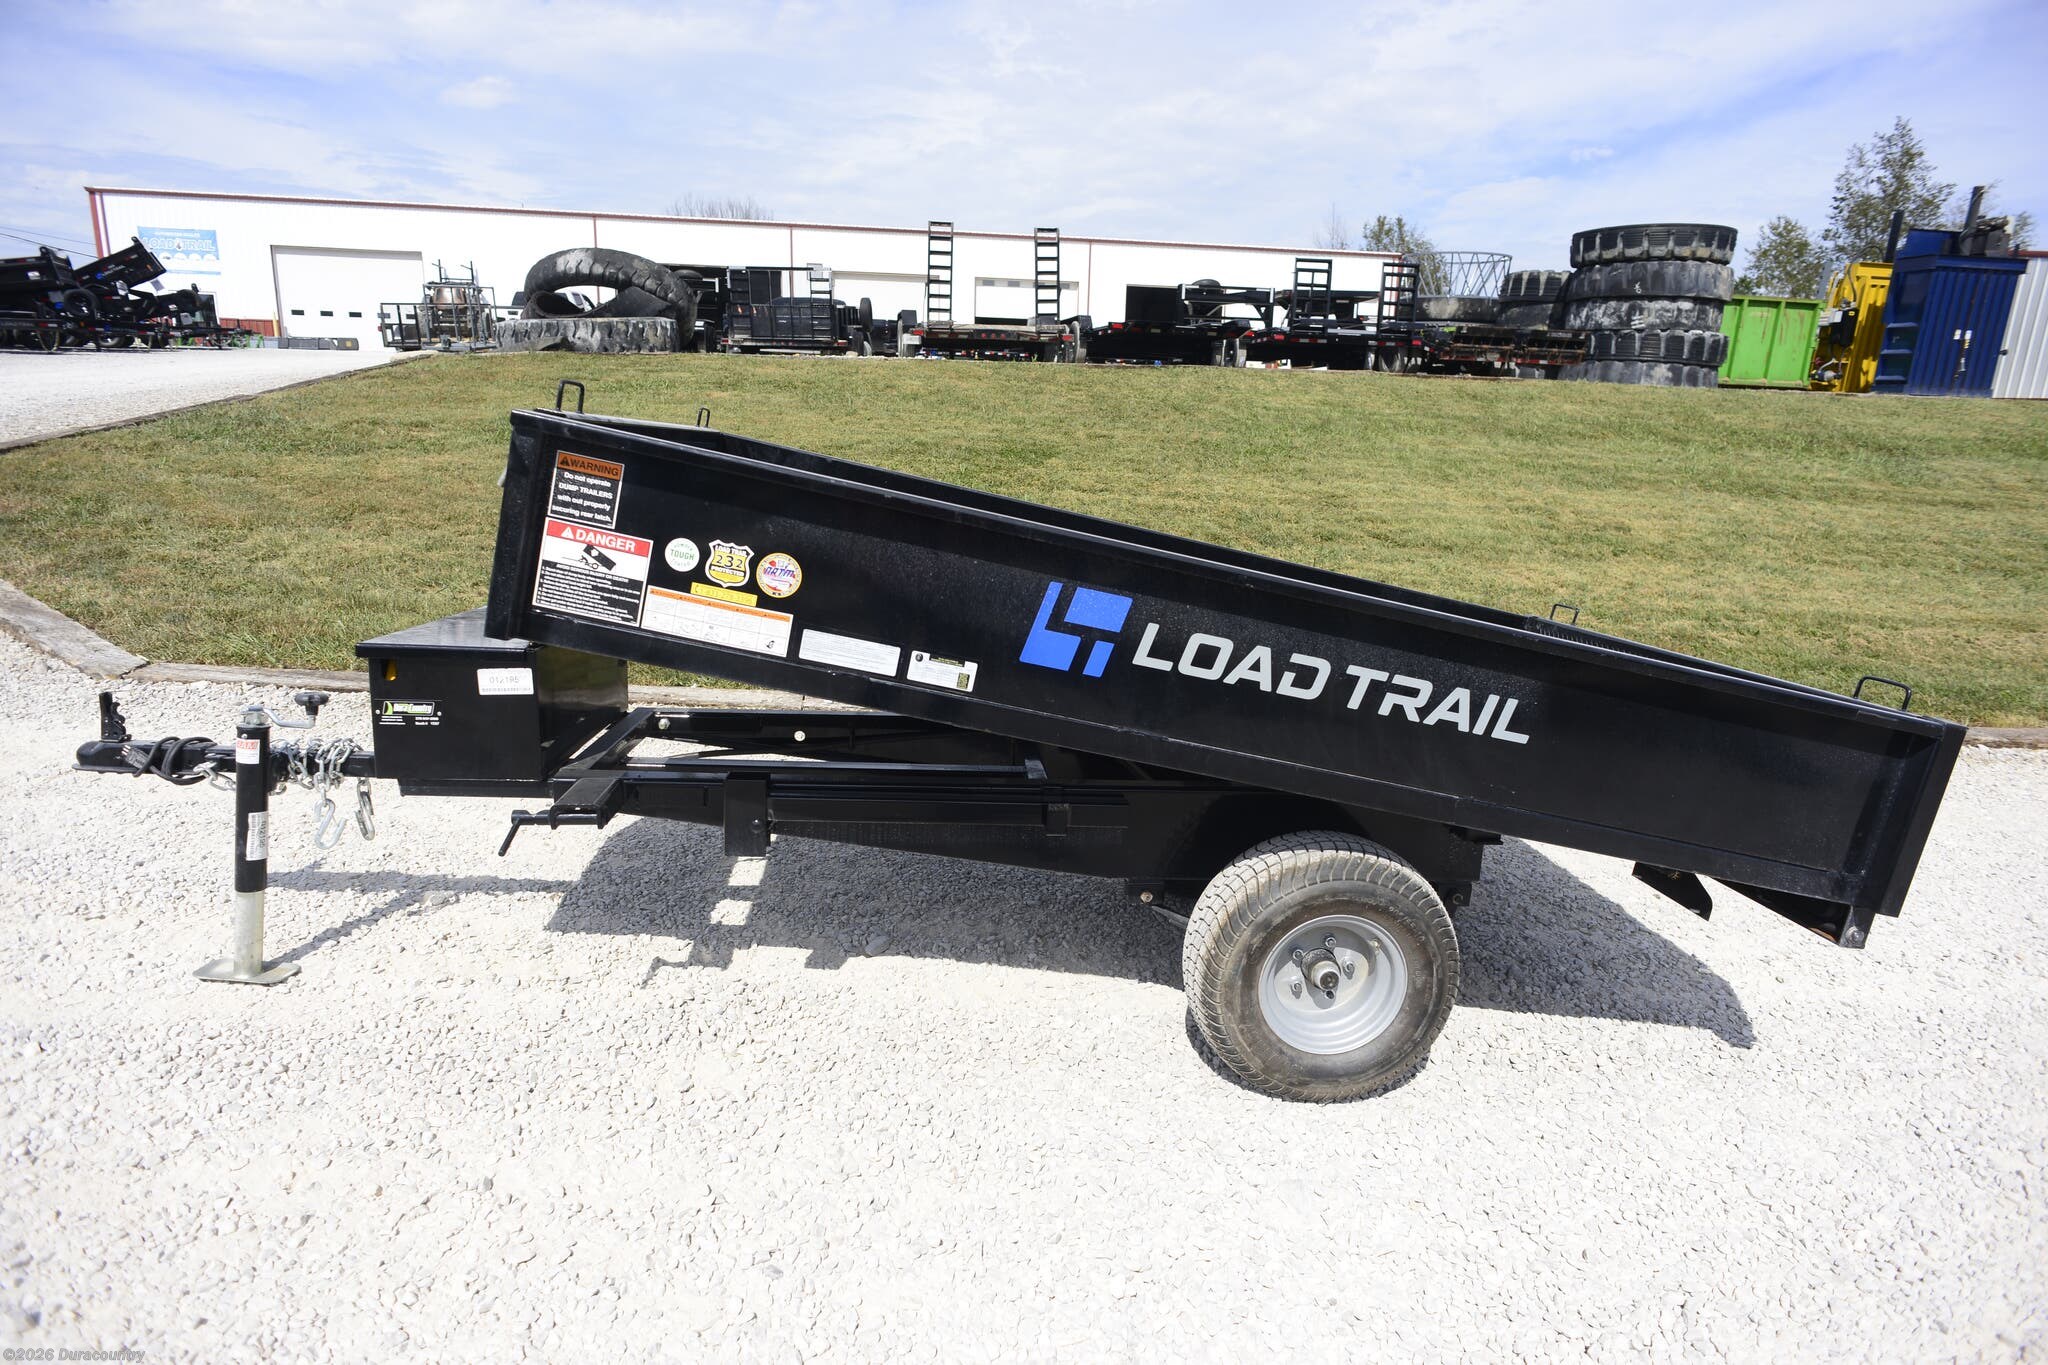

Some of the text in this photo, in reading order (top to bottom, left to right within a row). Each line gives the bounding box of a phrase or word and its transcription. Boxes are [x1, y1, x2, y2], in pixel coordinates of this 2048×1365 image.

[569, 458, 619, 476] WARNING
[564, 471, 612, 488] Do not operate
[558, 482, 613, 500] DUMP TRAILERS
[557, 494, 611, 512] with out properly
[575, 529, 636, 553] DANGER
[670, 549, 695, 561] TOUGH
[1132, 622, 1530, 744] LOAD TRAIL
